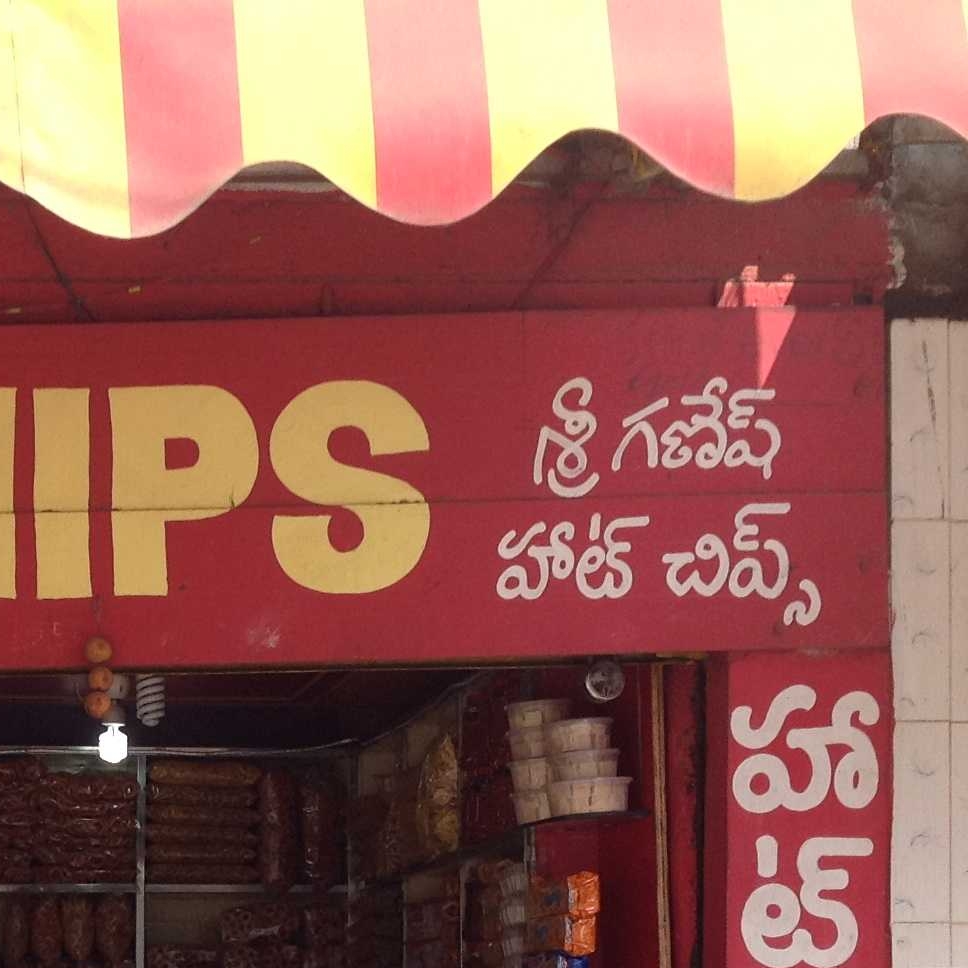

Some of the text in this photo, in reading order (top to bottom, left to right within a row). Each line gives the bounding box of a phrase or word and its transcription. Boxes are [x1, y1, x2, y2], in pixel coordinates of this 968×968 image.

[534, 376, 600, 497] శ్రీ
[497, 502, 822, 626] హాట్ చిప్స్
